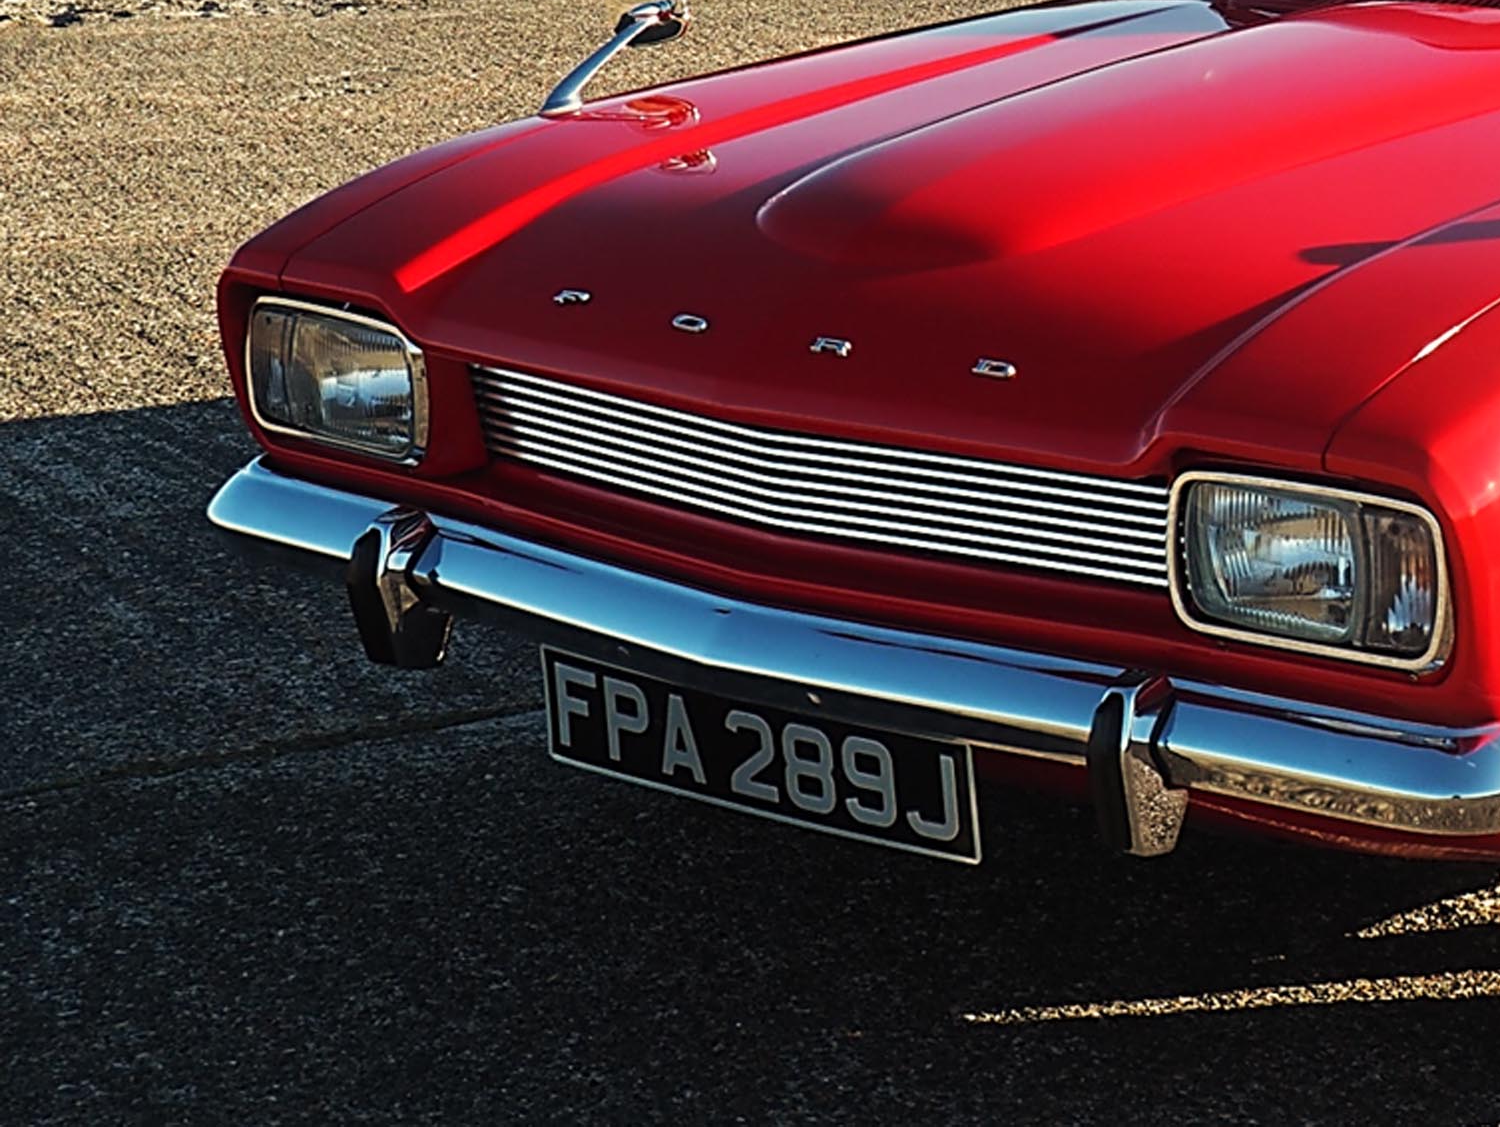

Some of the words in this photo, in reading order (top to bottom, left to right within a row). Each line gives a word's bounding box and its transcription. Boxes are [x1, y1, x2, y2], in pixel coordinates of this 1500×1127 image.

[553, 289, 1017, 379] FORD
[553, 661, 707, 785] FPA
[724, 709, 960, 842] 289J
